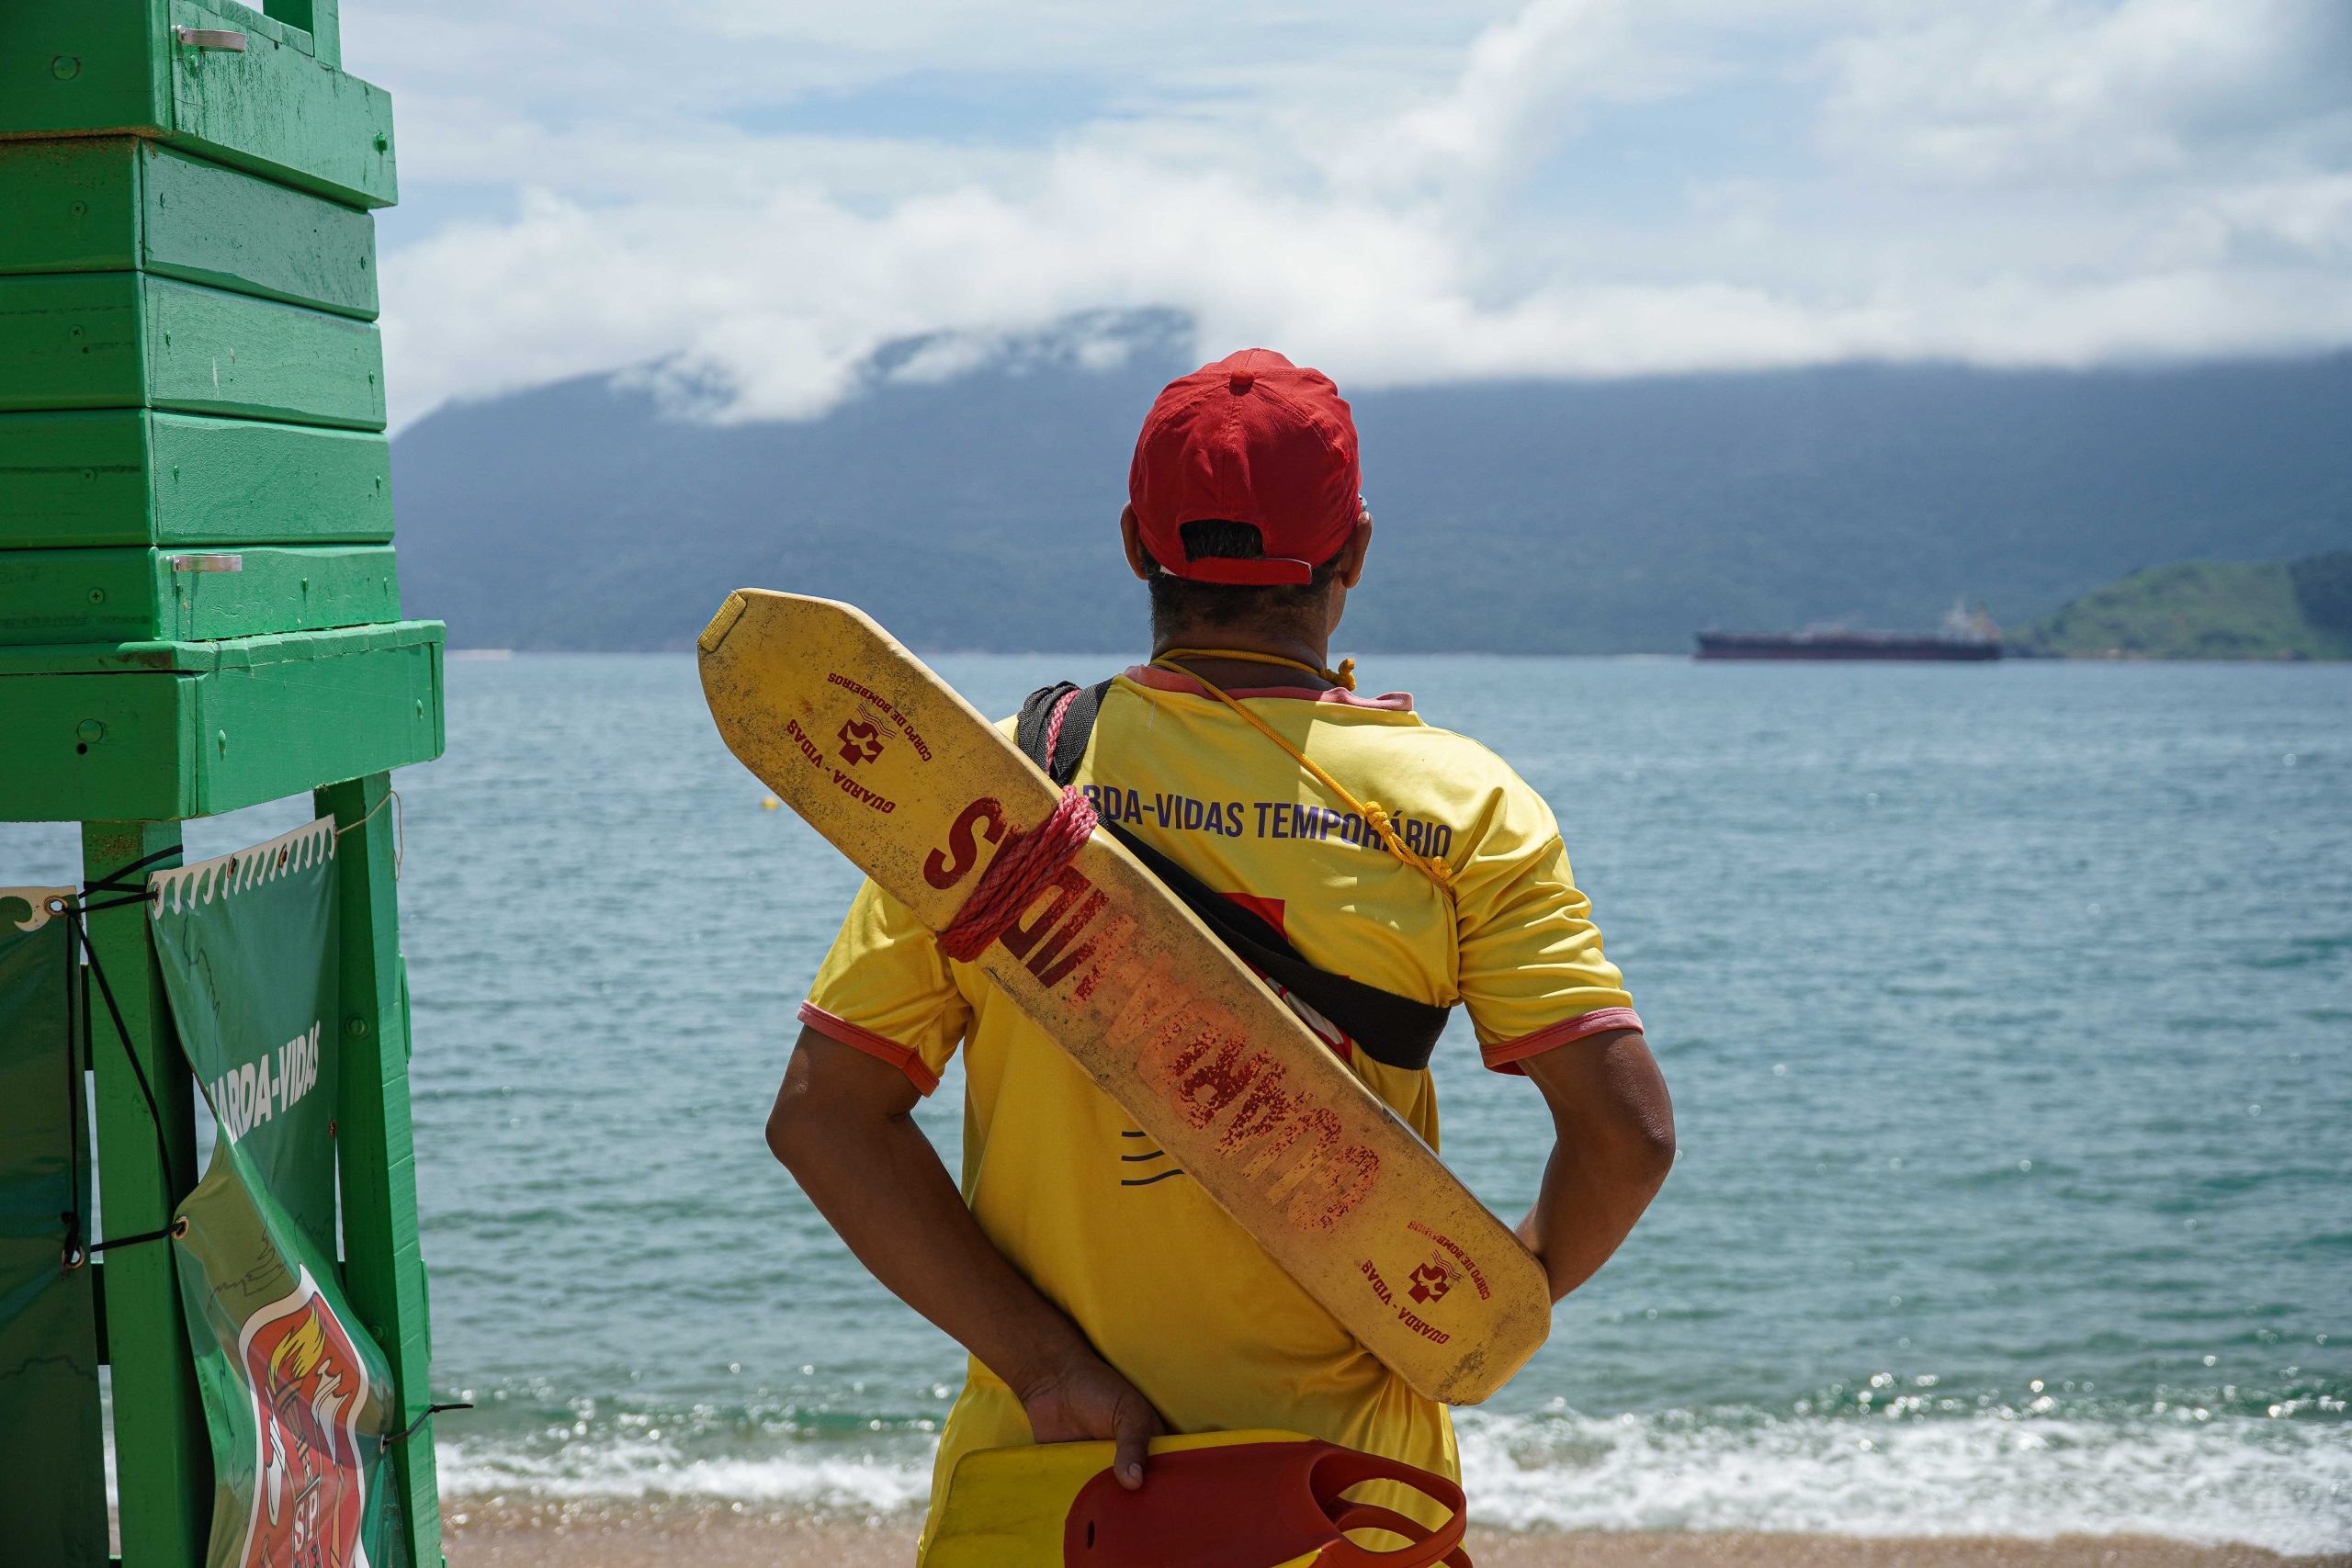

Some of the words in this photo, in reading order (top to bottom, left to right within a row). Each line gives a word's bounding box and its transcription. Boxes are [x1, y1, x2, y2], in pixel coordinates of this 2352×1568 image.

[827, 672, 892, 714] BOMBEIROS
[890, 710, 907, 728] DE
[786, 719, 823, 769] VIDAS
[903, 725, 932, 762] CORPO
[832, 769, 896, 814] GUARDA
[1361, 1259, 1393, 1306] VIDAS
[1461, 1256, 1476, 1272] DE
[1470, 1269, 1490, 1301] CORPO
[1397, 1306, 1451, 1345] GUARDA
